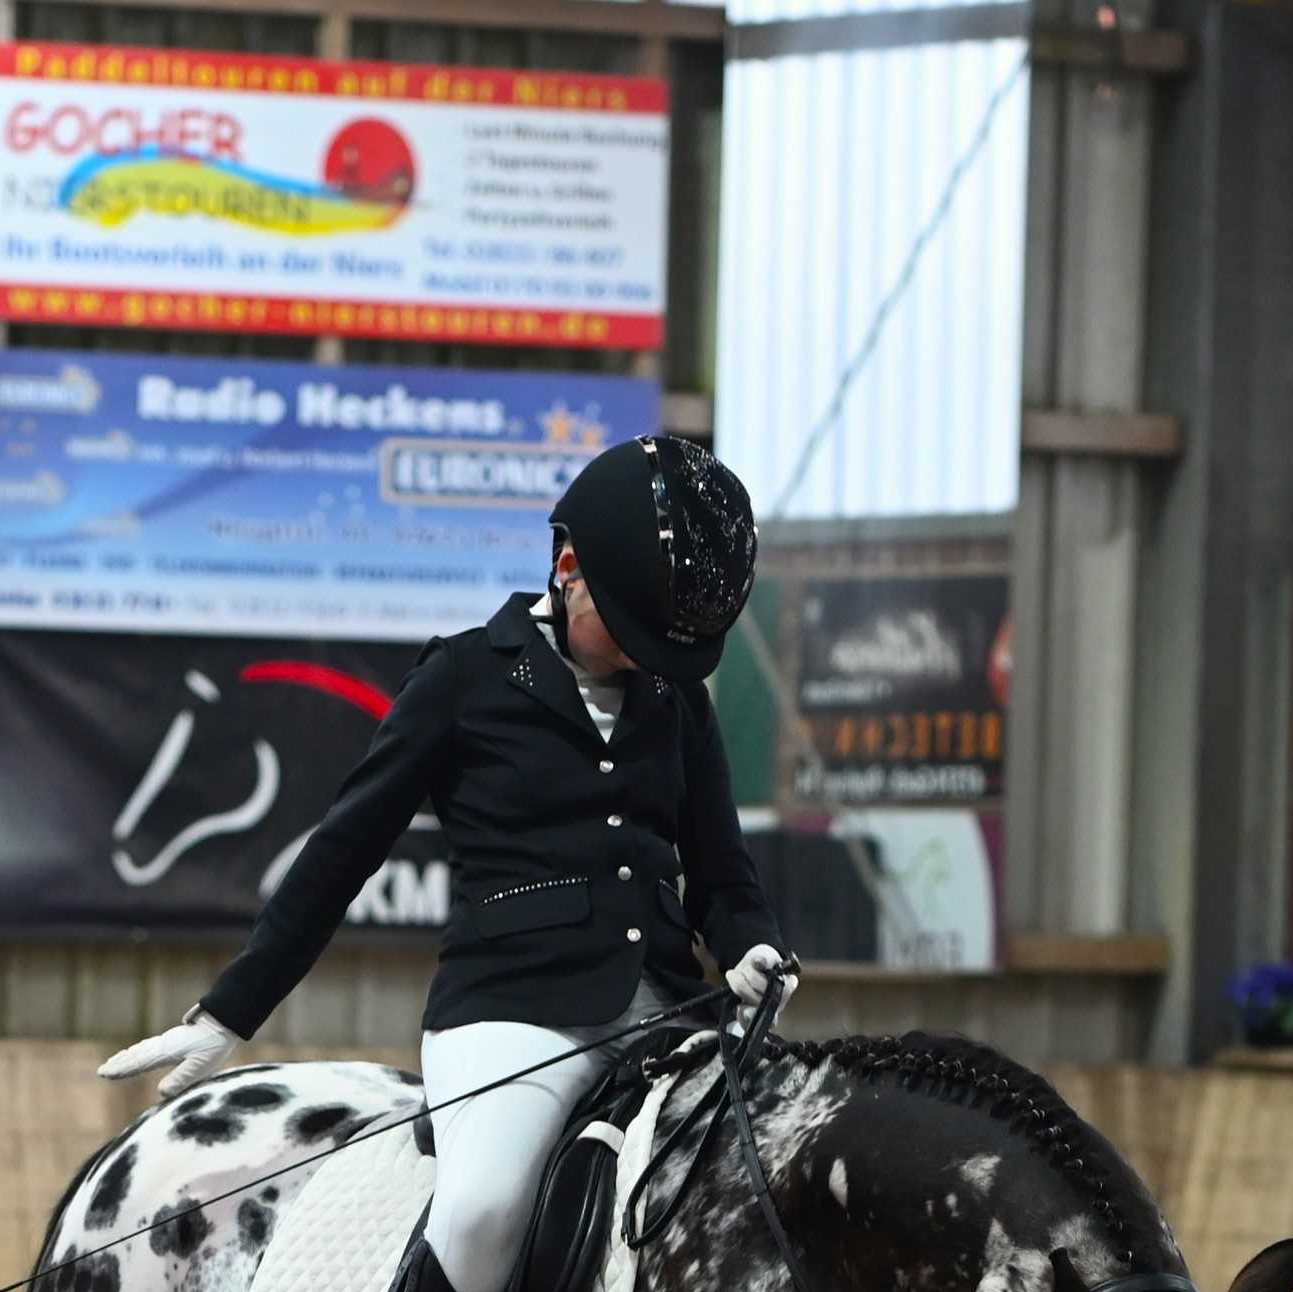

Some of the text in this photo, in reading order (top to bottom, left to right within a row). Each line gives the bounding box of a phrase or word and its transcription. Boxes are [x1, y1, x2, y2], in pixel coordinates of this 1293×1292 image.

[4, 100, 244, 164] GOCHER
[140, 375, 505, 433] Radio Heckens
